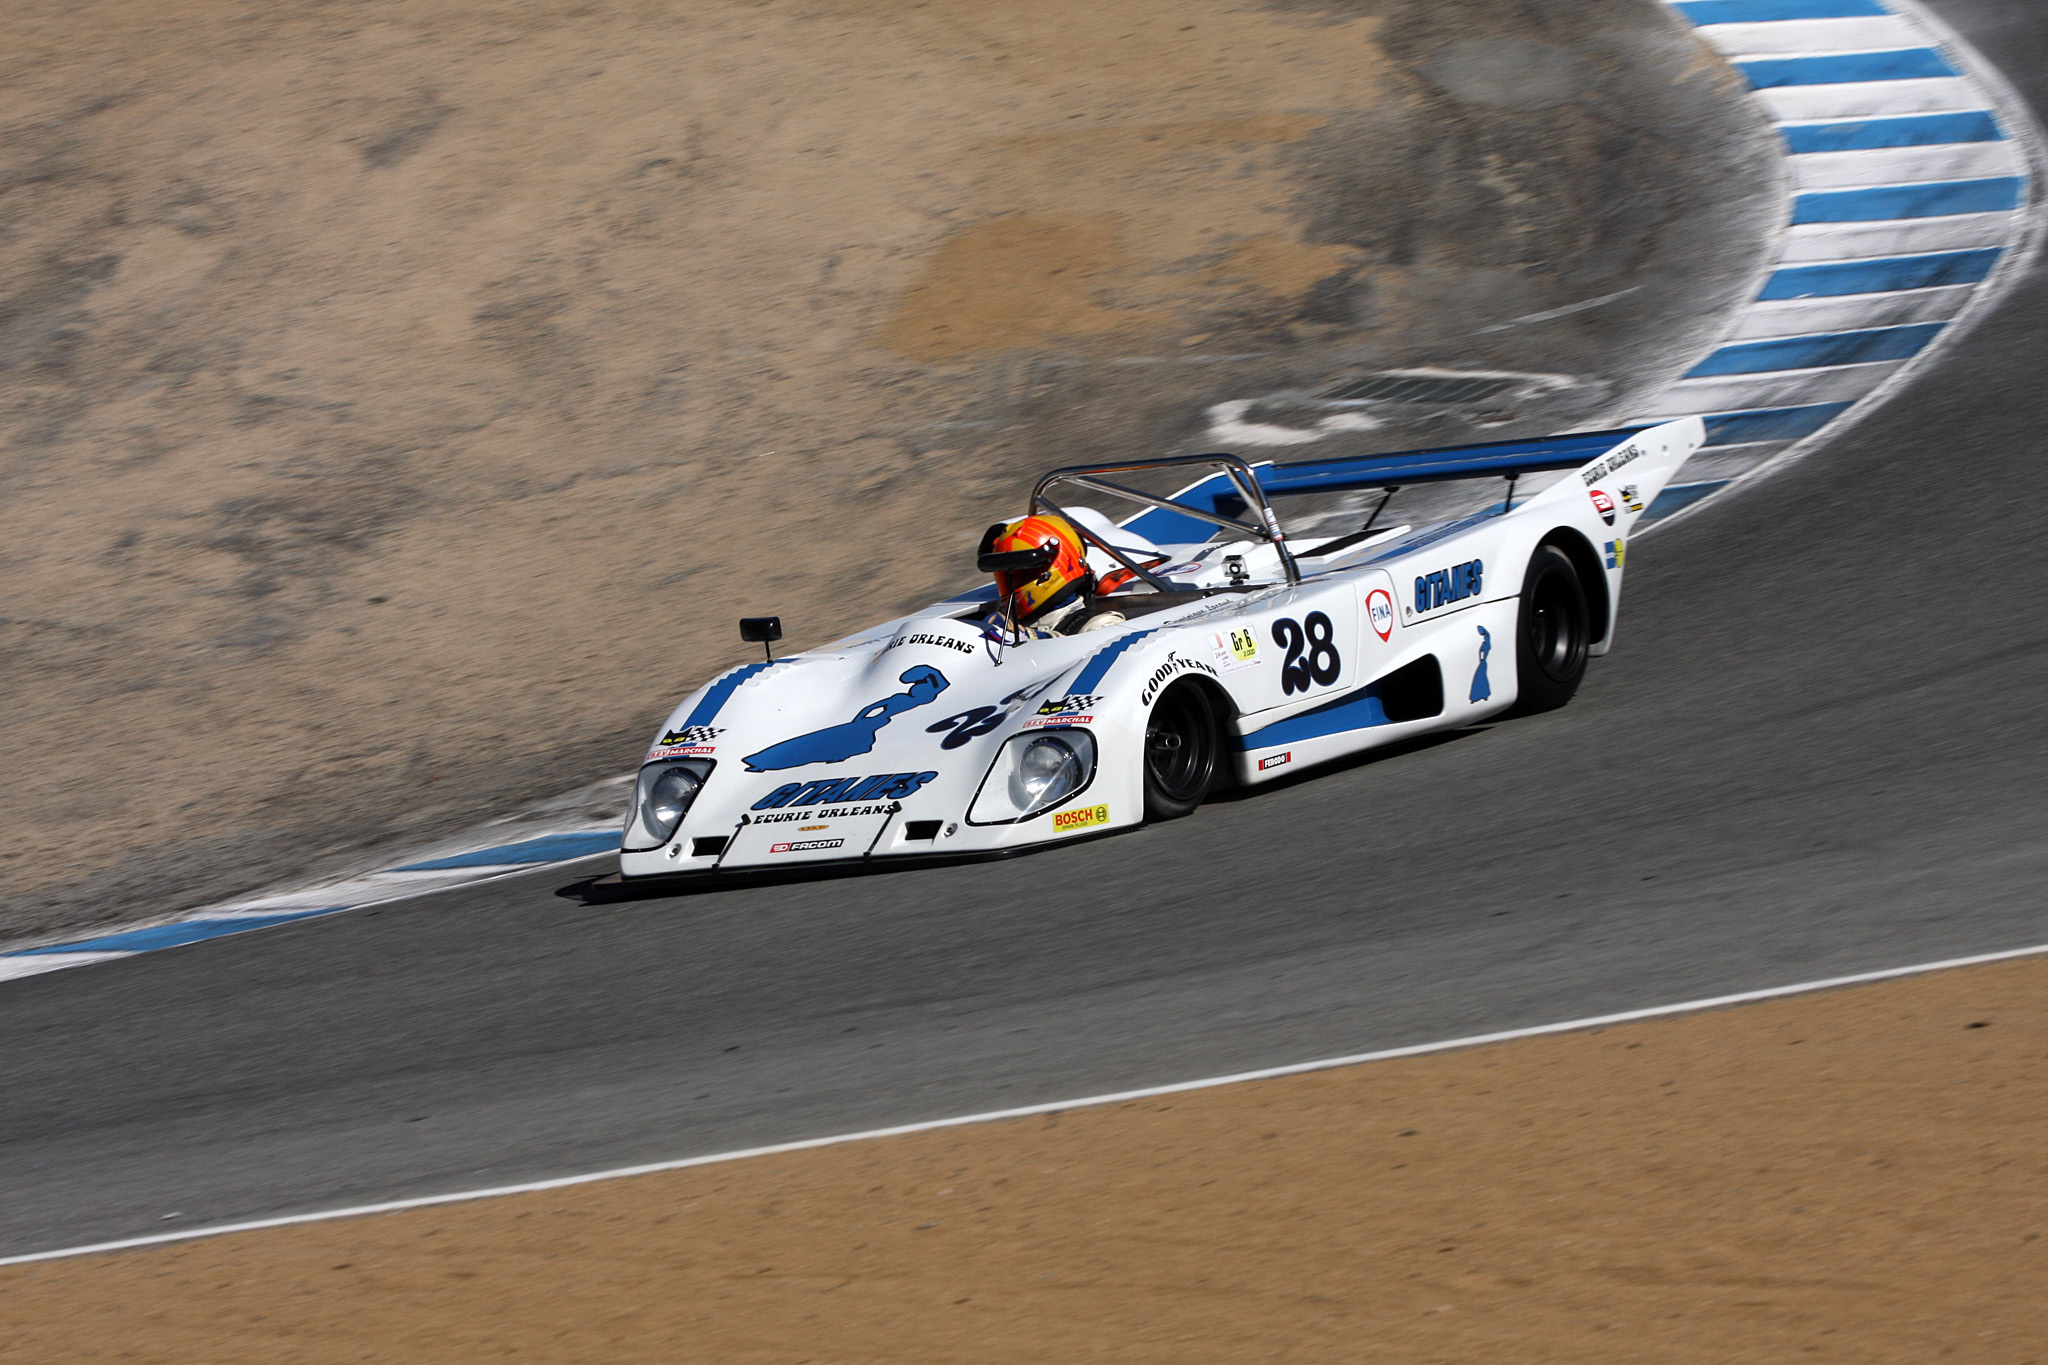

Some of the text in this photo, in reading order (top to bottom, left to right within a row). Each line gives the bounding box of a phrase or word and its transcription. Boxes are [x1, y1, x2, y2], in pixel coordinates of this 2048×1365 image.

[1414, 558, 1483, 613] GITANES
[1371, 604, 1391, 622] FINA
[909, 634, 975, 654] ORLEANS
[1231, 629, 1252, 651] Gr 6
[1271, 610, 1341, 696] 28
[1047, 716, 1090, 725] MARCHAL
[670, 747, 712, 755] MARCHAL
[1264, 754, 1286, 768] FERODO
[750, 771, 939, 811] GITANES
[753, 804, 894, 825] ECURIE ORLEANS
[1055, 808, 1093, 826] BOSCH
[791, 840, 843, 851] FACOM
